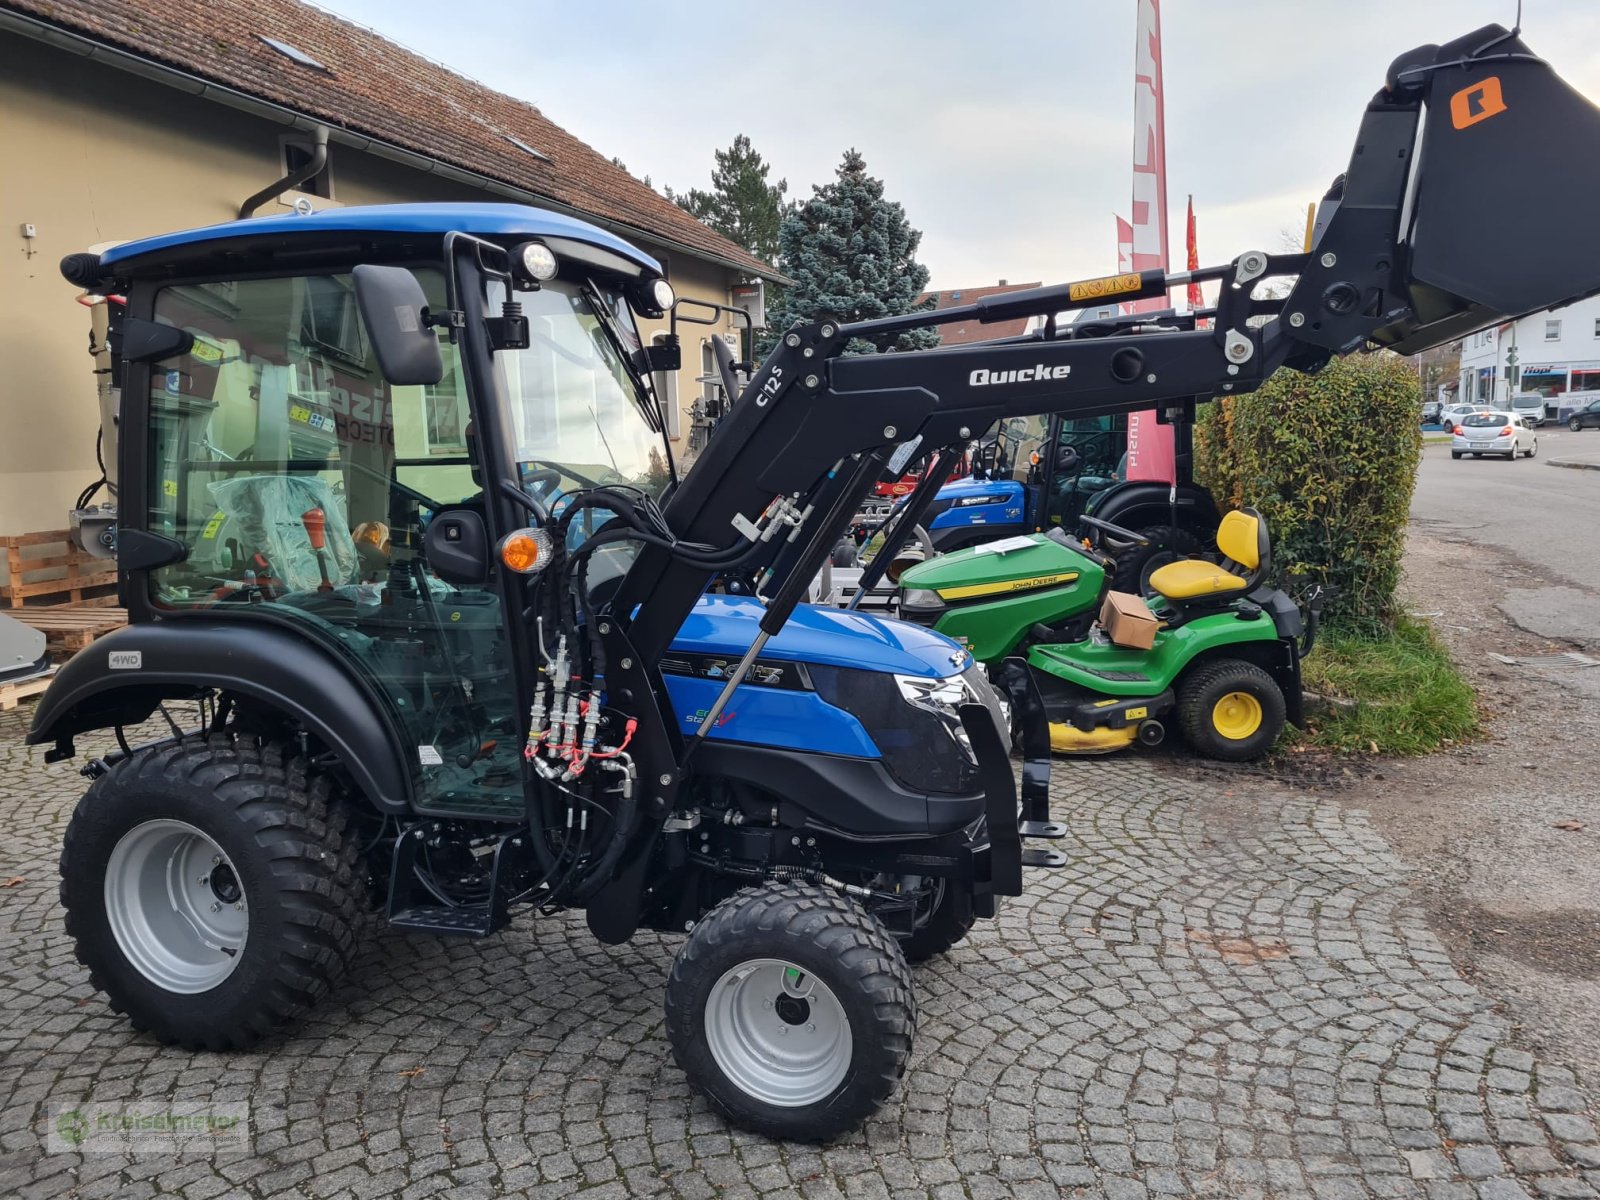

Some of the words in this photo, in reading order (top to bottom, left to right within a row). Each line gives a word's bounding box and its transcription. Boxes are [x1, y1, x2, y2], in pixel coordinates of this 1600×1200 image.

[969, 364, 1071, 386] Quicke
[1011, 581, 1032, 589] JOHN
[1032, 577, 1058, 586] DEERE
[112, 655, 138, 665] 4WD
